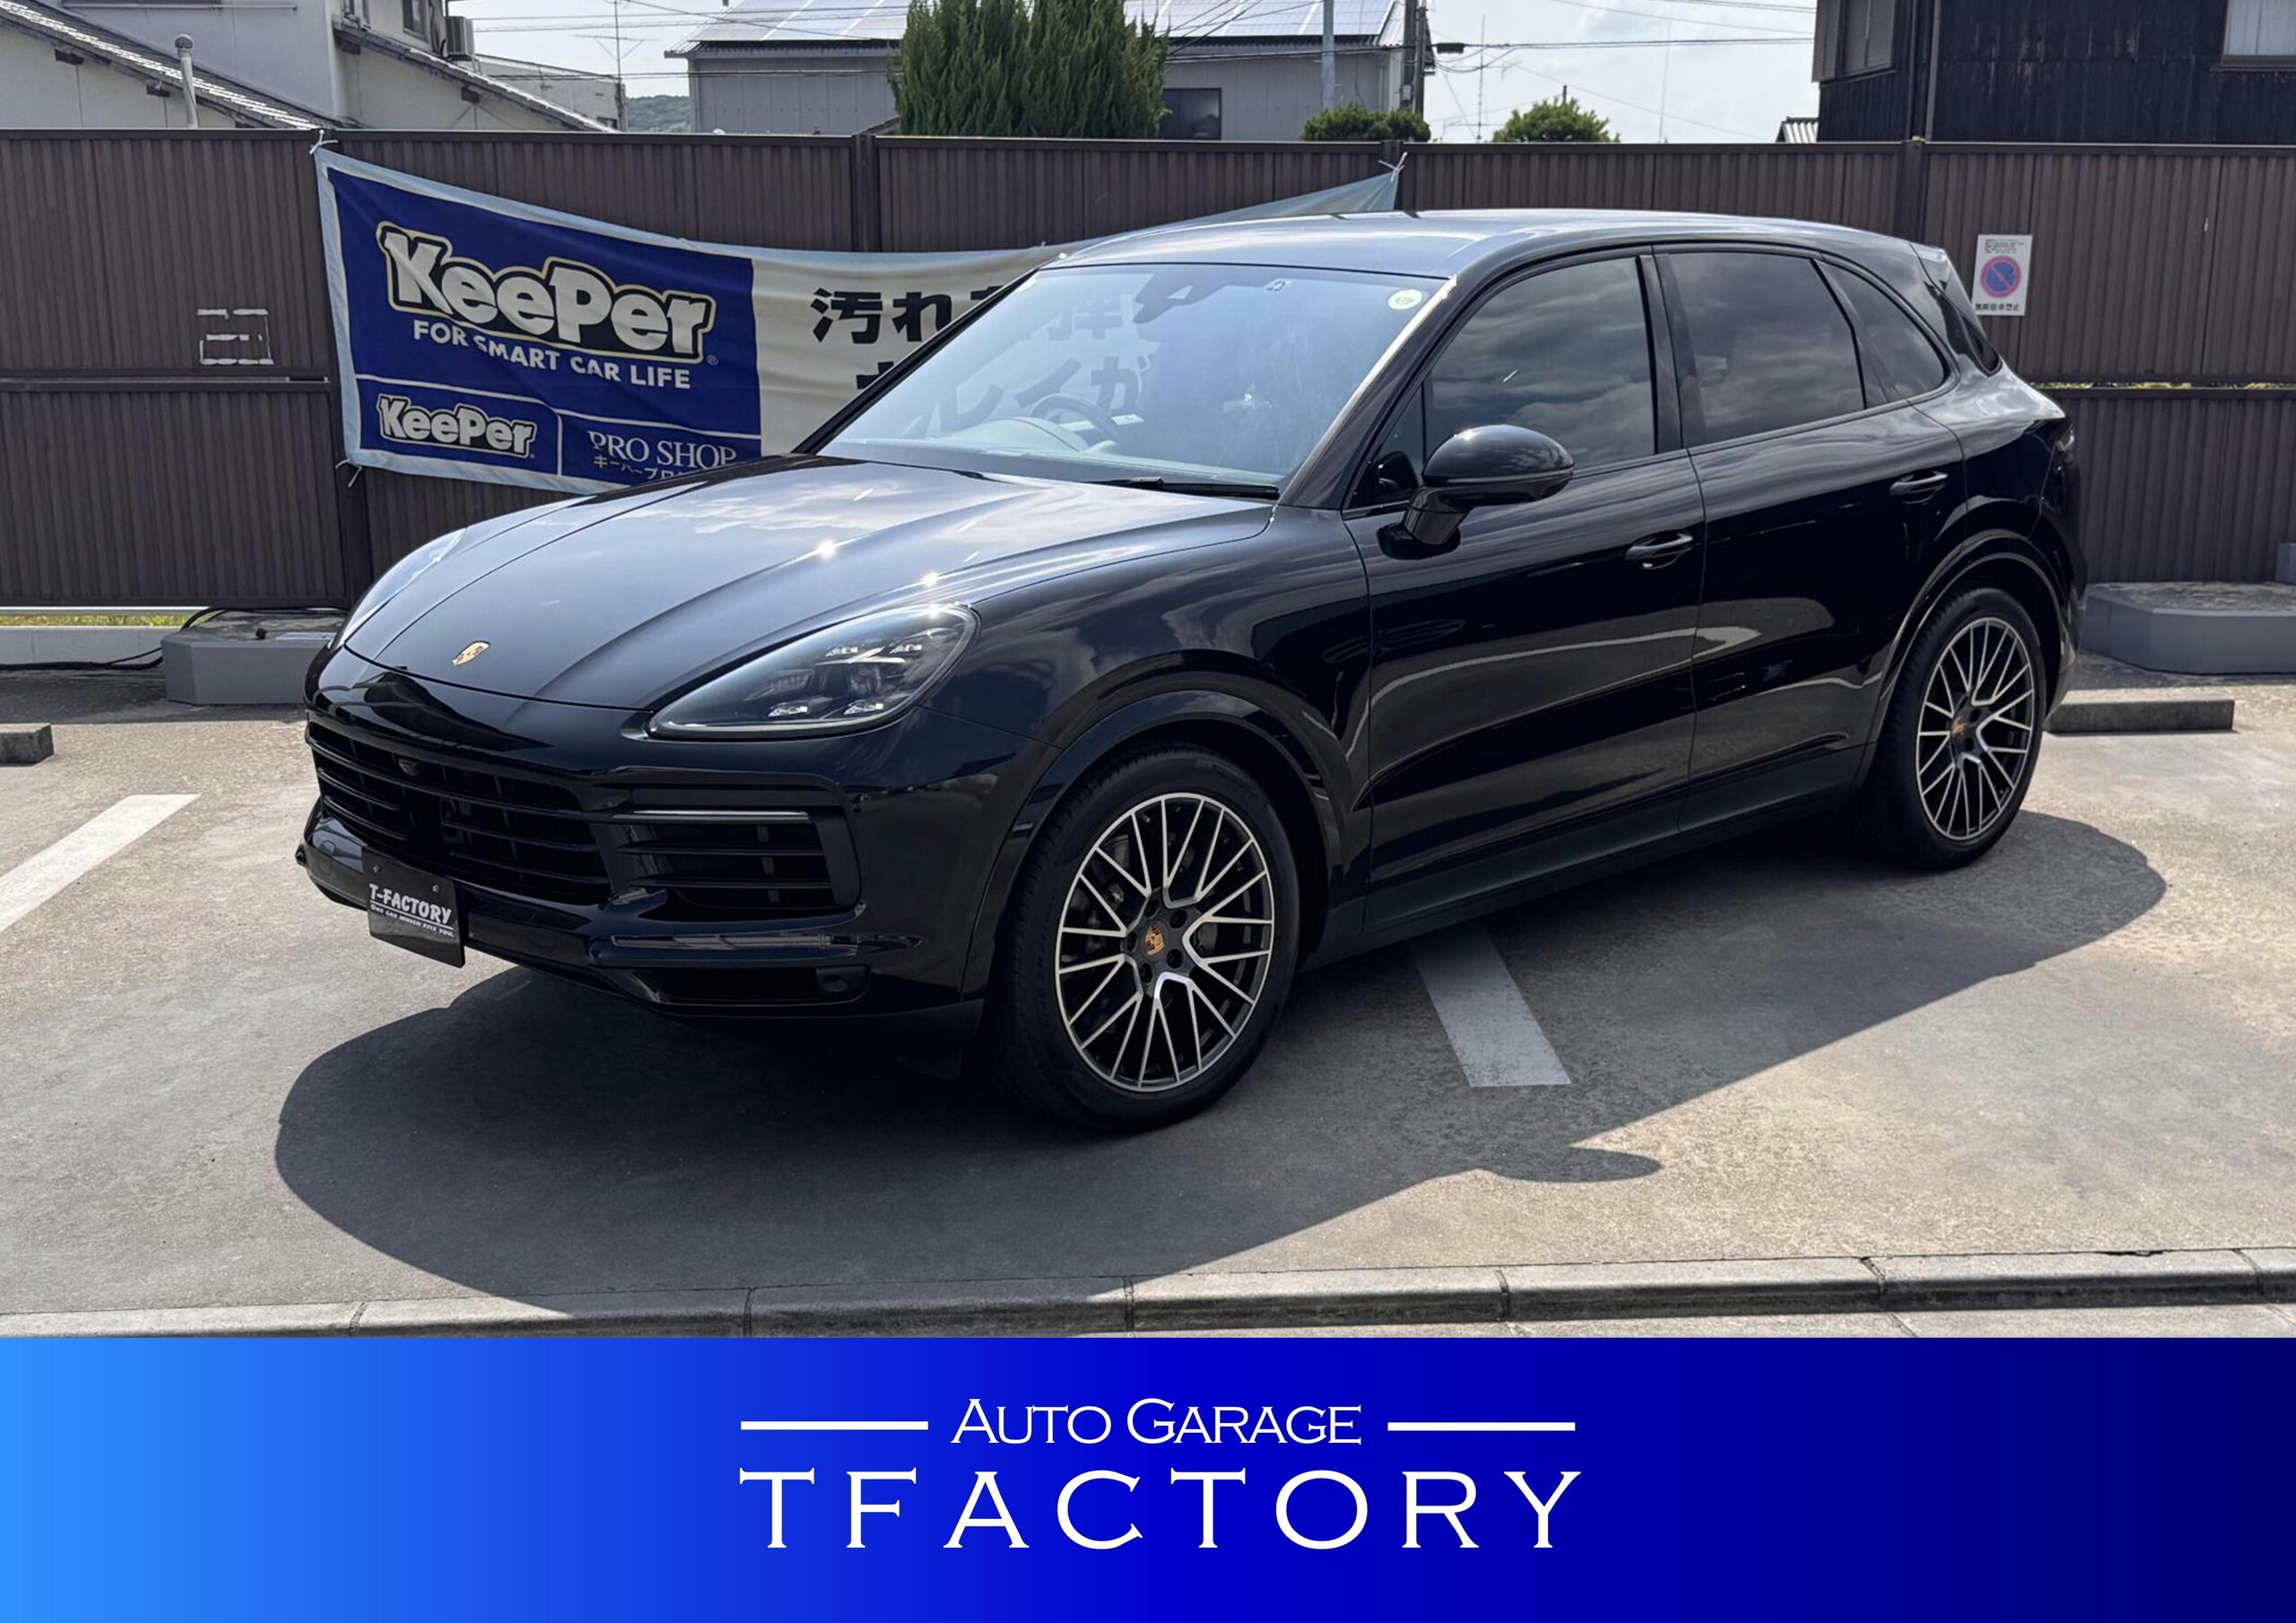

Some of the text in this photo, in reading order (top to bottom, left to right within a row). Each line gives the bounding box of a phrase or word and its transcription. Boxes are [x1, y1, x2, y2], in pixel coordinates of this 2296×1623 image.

[380, 228, 709, 357] KeePer
[413, 319, 691, 389] FOR SMART CAR LIFE
[379, 396, 533, 455] KeePer
[587, 430, 737, 470] PRO SHOP
[369, 882, 452, 924] T-FACTORY
